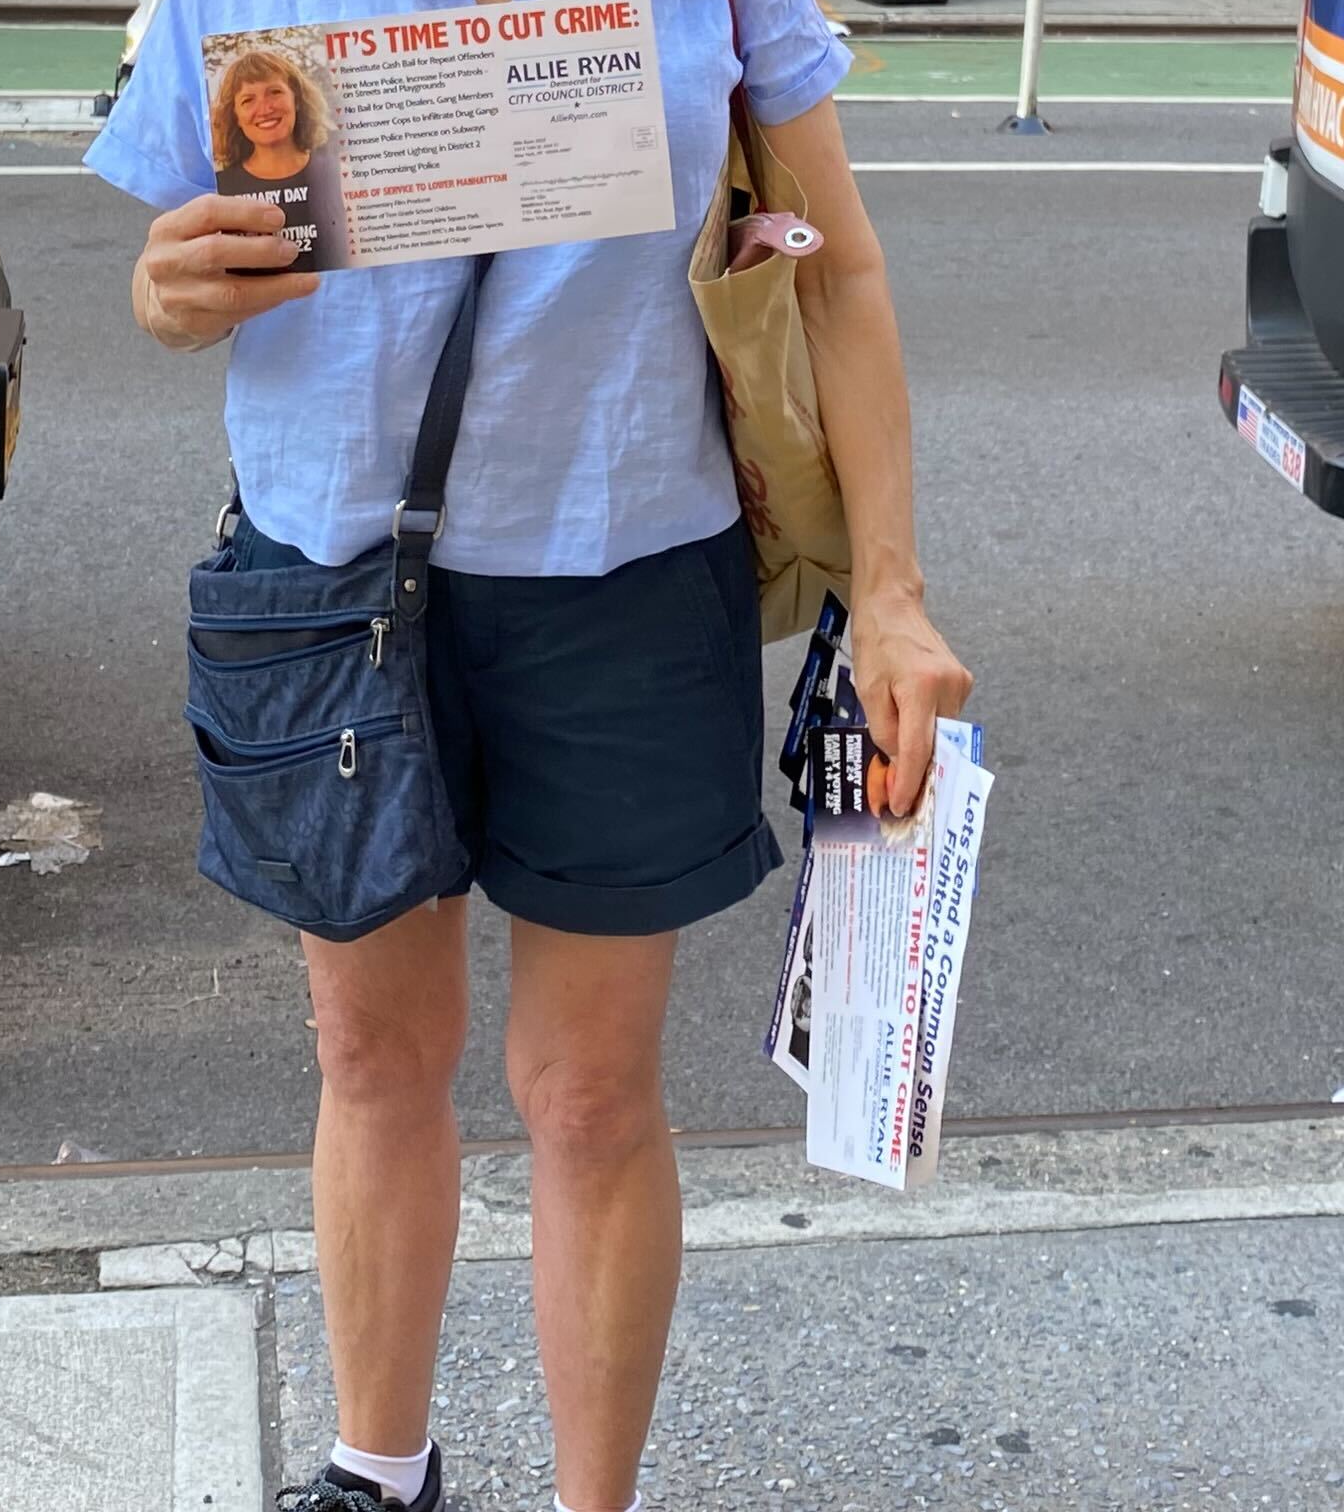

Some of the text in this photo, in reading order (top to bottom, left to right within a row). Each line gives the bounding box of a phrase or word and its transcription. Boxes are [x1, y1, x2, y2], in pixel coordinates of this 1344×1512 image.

[325, 2, 640, 60] IT'S TIME TO CUT CRIME:
[340, 52, 494, 74] Reinstitute Cash Bail for Repeat Offenders
[507, 52, 641, 83] ALLIE RYAN
[509, 81, 643, 106] CITY COUNCIL DISTRICT 2
[550, 76, 601, 88] Democrat for
[358, 104, 371, 113] Bail
[386, 100, 404, 110] Drug
[437, 96, 456, 105] Gang
[458, 91, 493, 101] Members
[346, 119, 390, 129] Undercover
[392, 117, 411, 125] Cops
[422, 112, 454, 121] Infiltrate
[456, 110, 474, 119] Drug
[476, 107, 499, 116] Gangs
[551, 111, 607, 123] AllieRyan.com
[348, 138, 379, 146] Increase
[381, 133, 402, 142] Police
[405, 130, 439, 139] Presence
[452, 125, 485, 134] Subways
[350, 153, 381, 162] Improve
[384, 150, 405, 159] Street
[408, 145, 438, 156] Lighting
[448, 142, 474, 151] District
[476, 140, 480, 148] 2
[352, 162, 440, 179] Stop Demonizing Police
[237, 187, 308, 204] MARY DAY
[280, 225, 317, 241] OTING
[832, 733, 841, 815] EARLY VOTING
[853, 734, 862, 812] PRIMARY DAY
[960, 791, 980, 848] Lets
[931, 829, 957, 927] Fighter
[947, 854, 968, 925] Send
[908, 909, 922, 971] TIME
[925, 934, 938, 960] to
[943, 930, 954, 946] a
[906, 981, 917, 1014] TO
[921, 955, 953, 1074] Common
[900, 1024, 913, 1073] CUT
[909, 1080, 933, 1158] Sense
